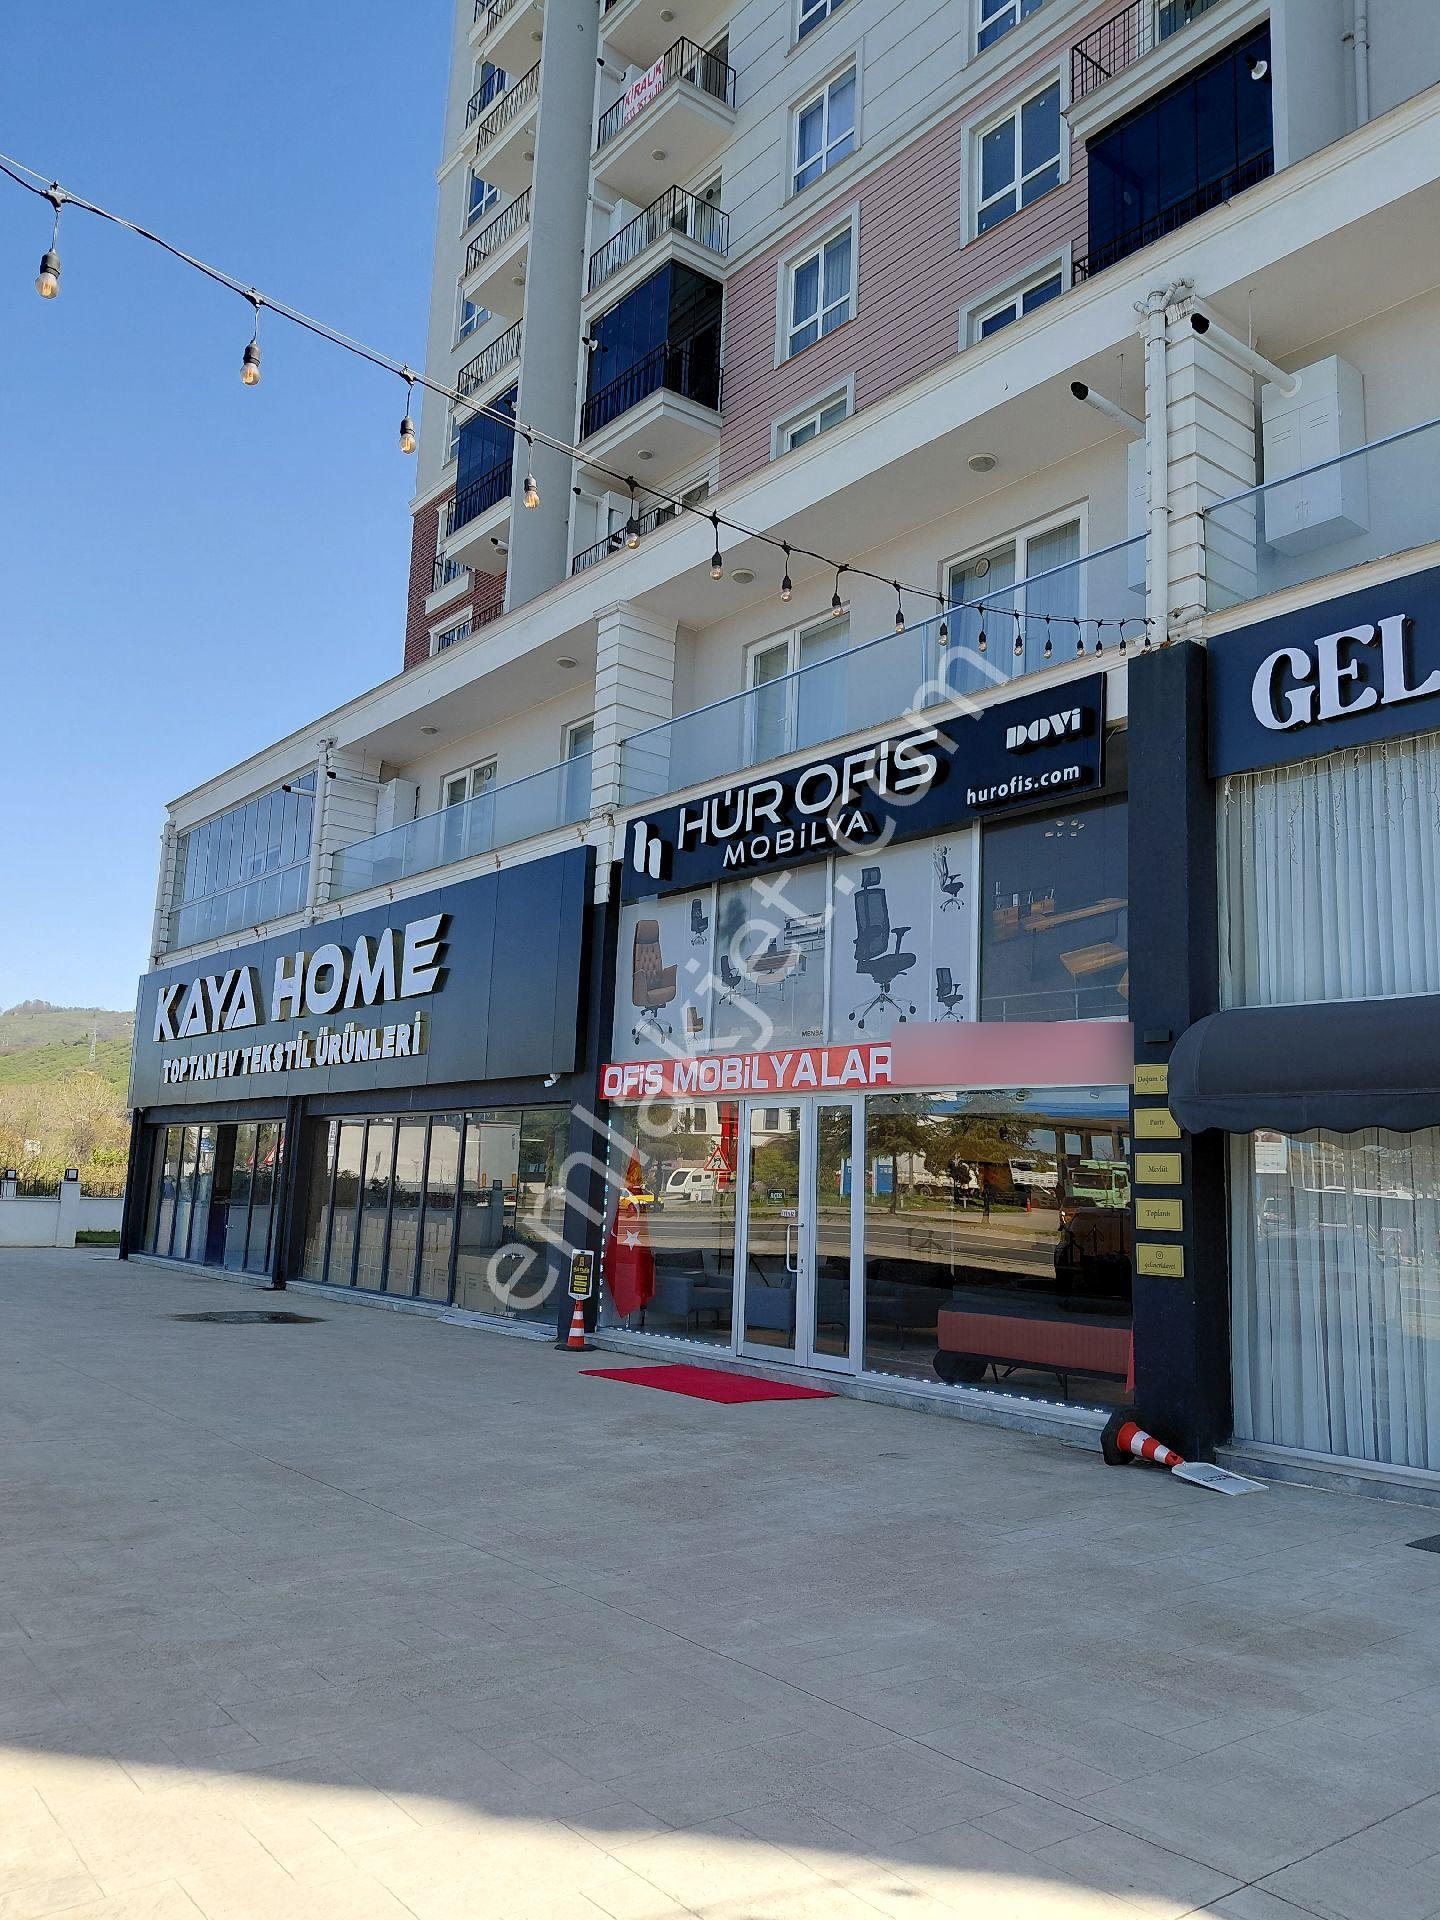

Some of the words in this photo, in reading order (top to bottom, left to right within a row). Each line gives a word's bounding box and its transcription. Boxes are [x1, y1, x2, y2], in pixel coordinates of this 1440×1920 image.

[966, 765, 1080, 805] hurofis.com
[153, 965, 258, 1042] KAYA
[271, 913, 444, 1022] HOME
[163, 1056, 214, 1084] TOPTAN
[217, 1050, 238, 1079] EV
[241, 1030, 311, 1075] TEKSTİL
[316, 1011, 422, 1066] ÜRÜNLERİ
